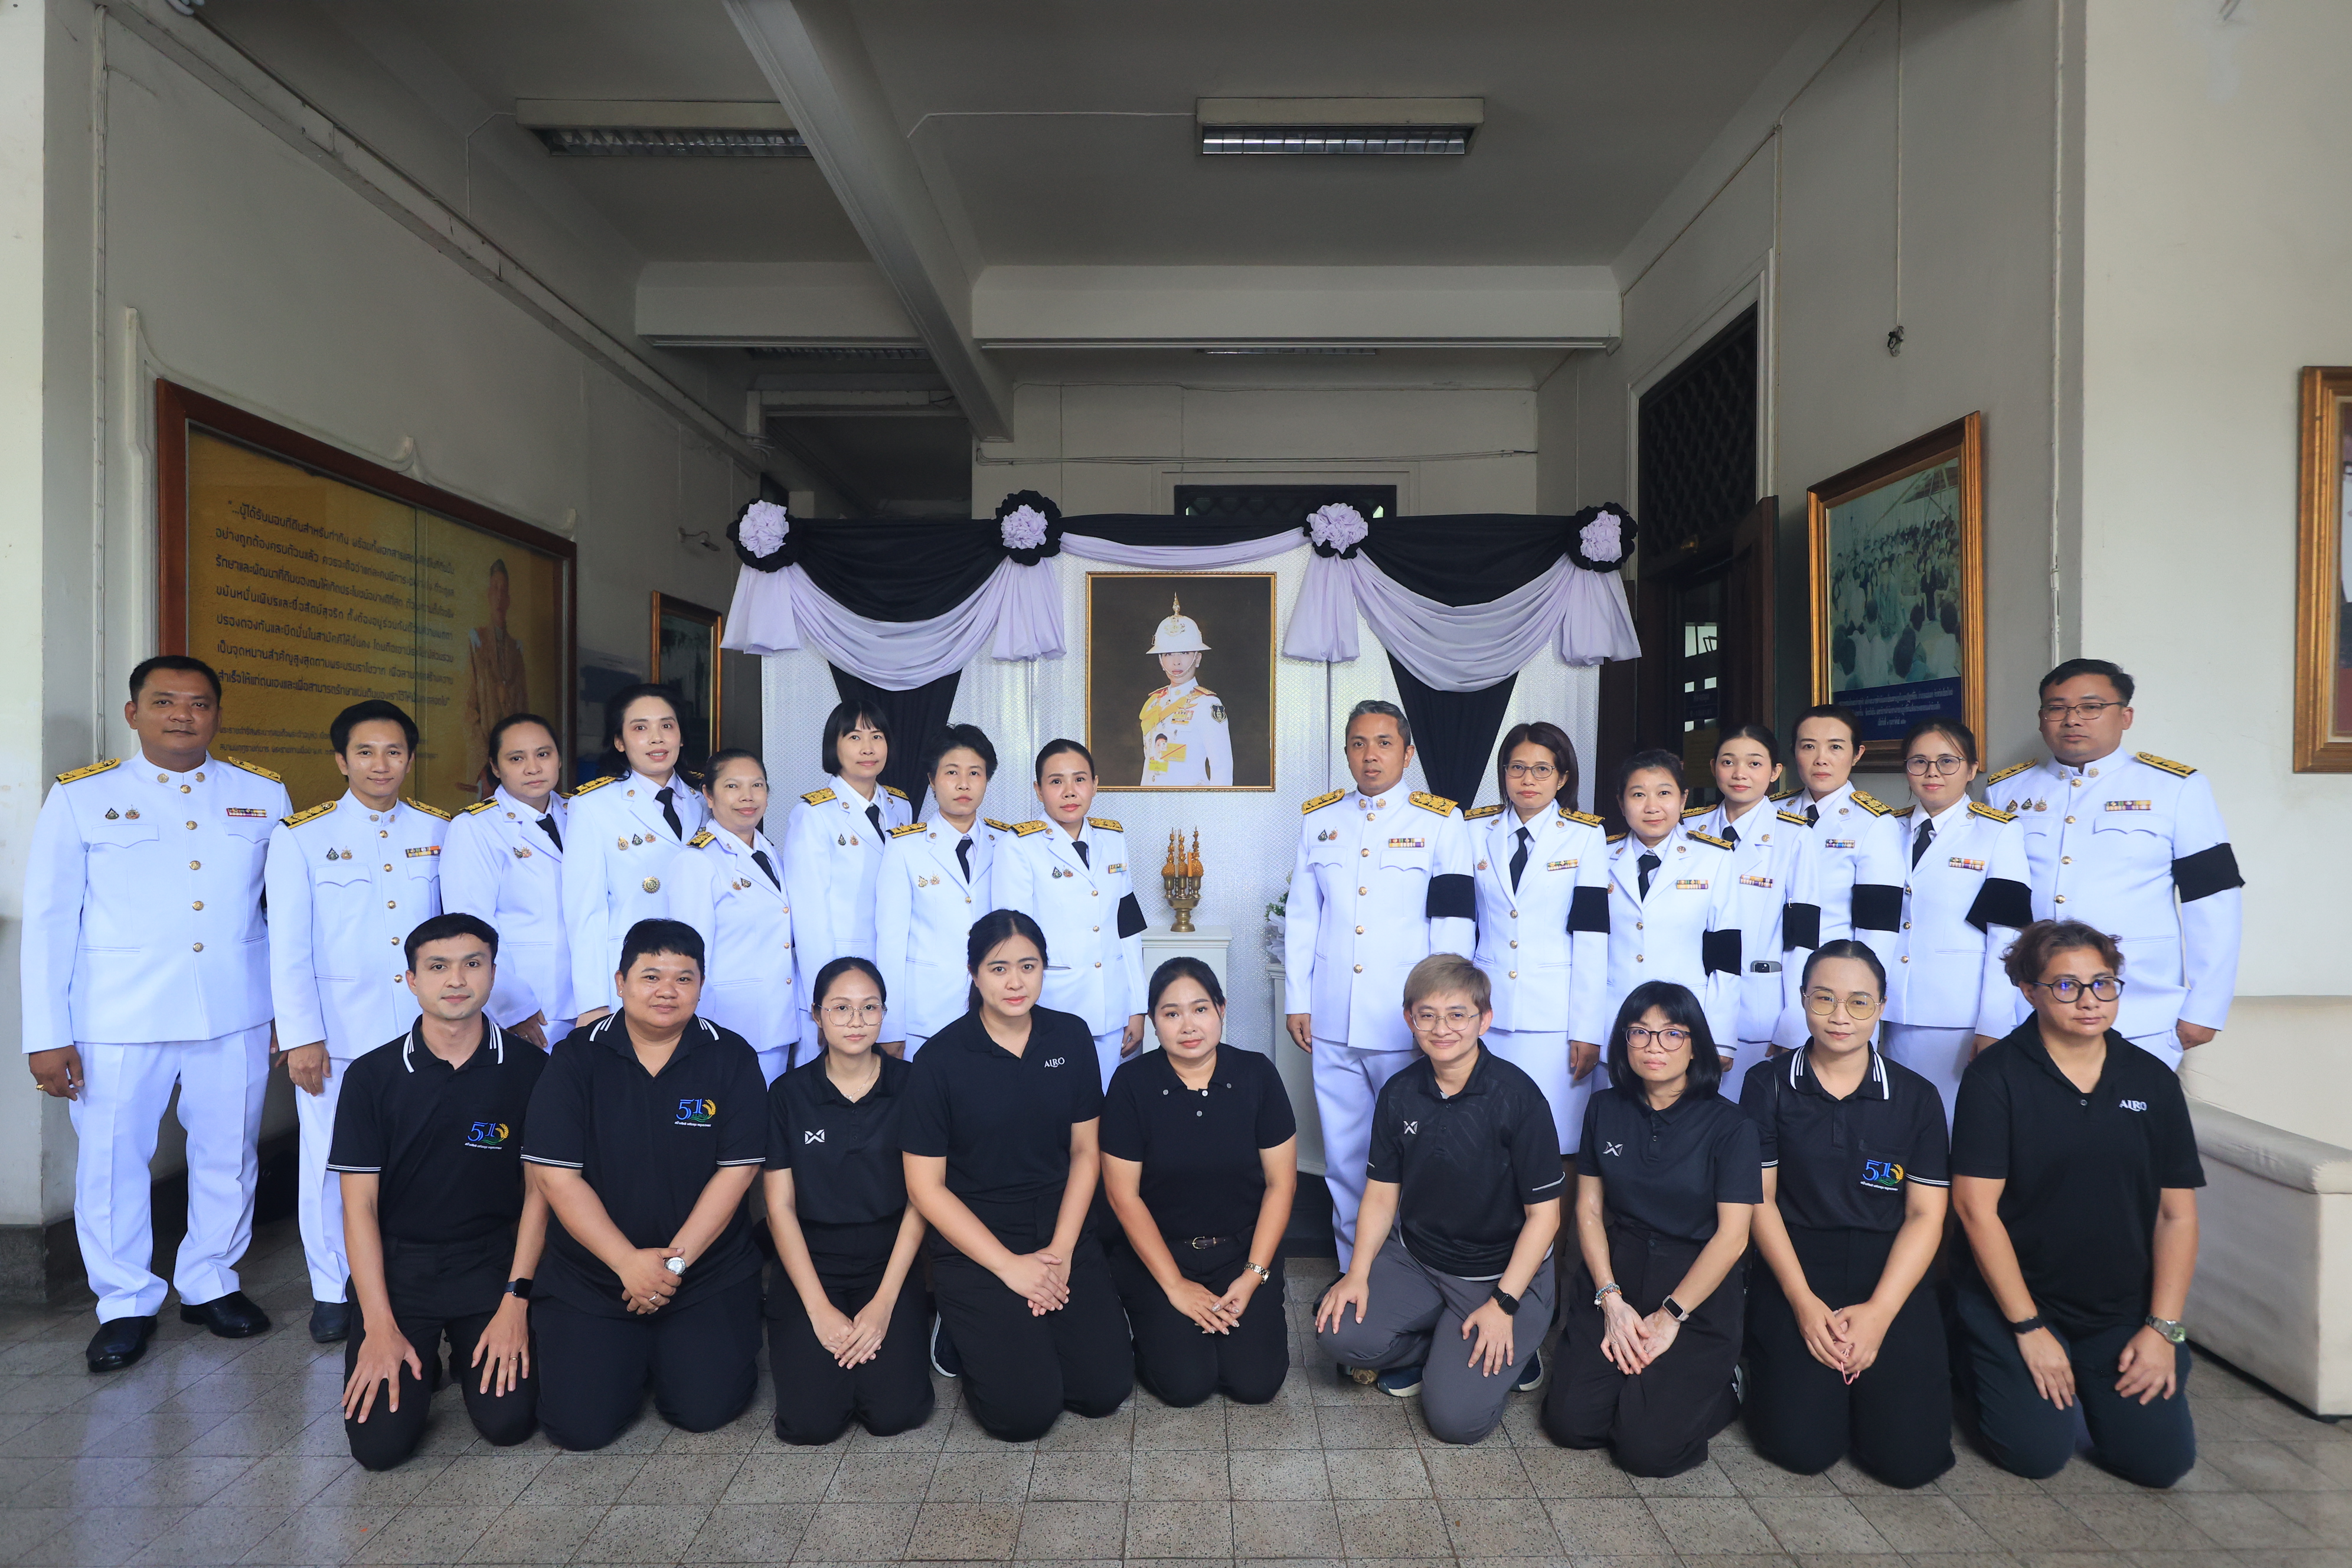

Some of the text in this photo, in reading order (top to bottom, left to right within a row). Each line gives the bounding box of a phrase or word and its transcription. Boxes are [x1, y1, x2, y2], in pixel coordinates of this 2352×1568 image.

[215, 527, 319, 562] อย่างถูกต้องครบถ้วนแล้ว
[676, 1098, 703, 1121] 51
[467, 1121, 496, 1142] 51
[1862, 1159, 1892, 1181] 51
